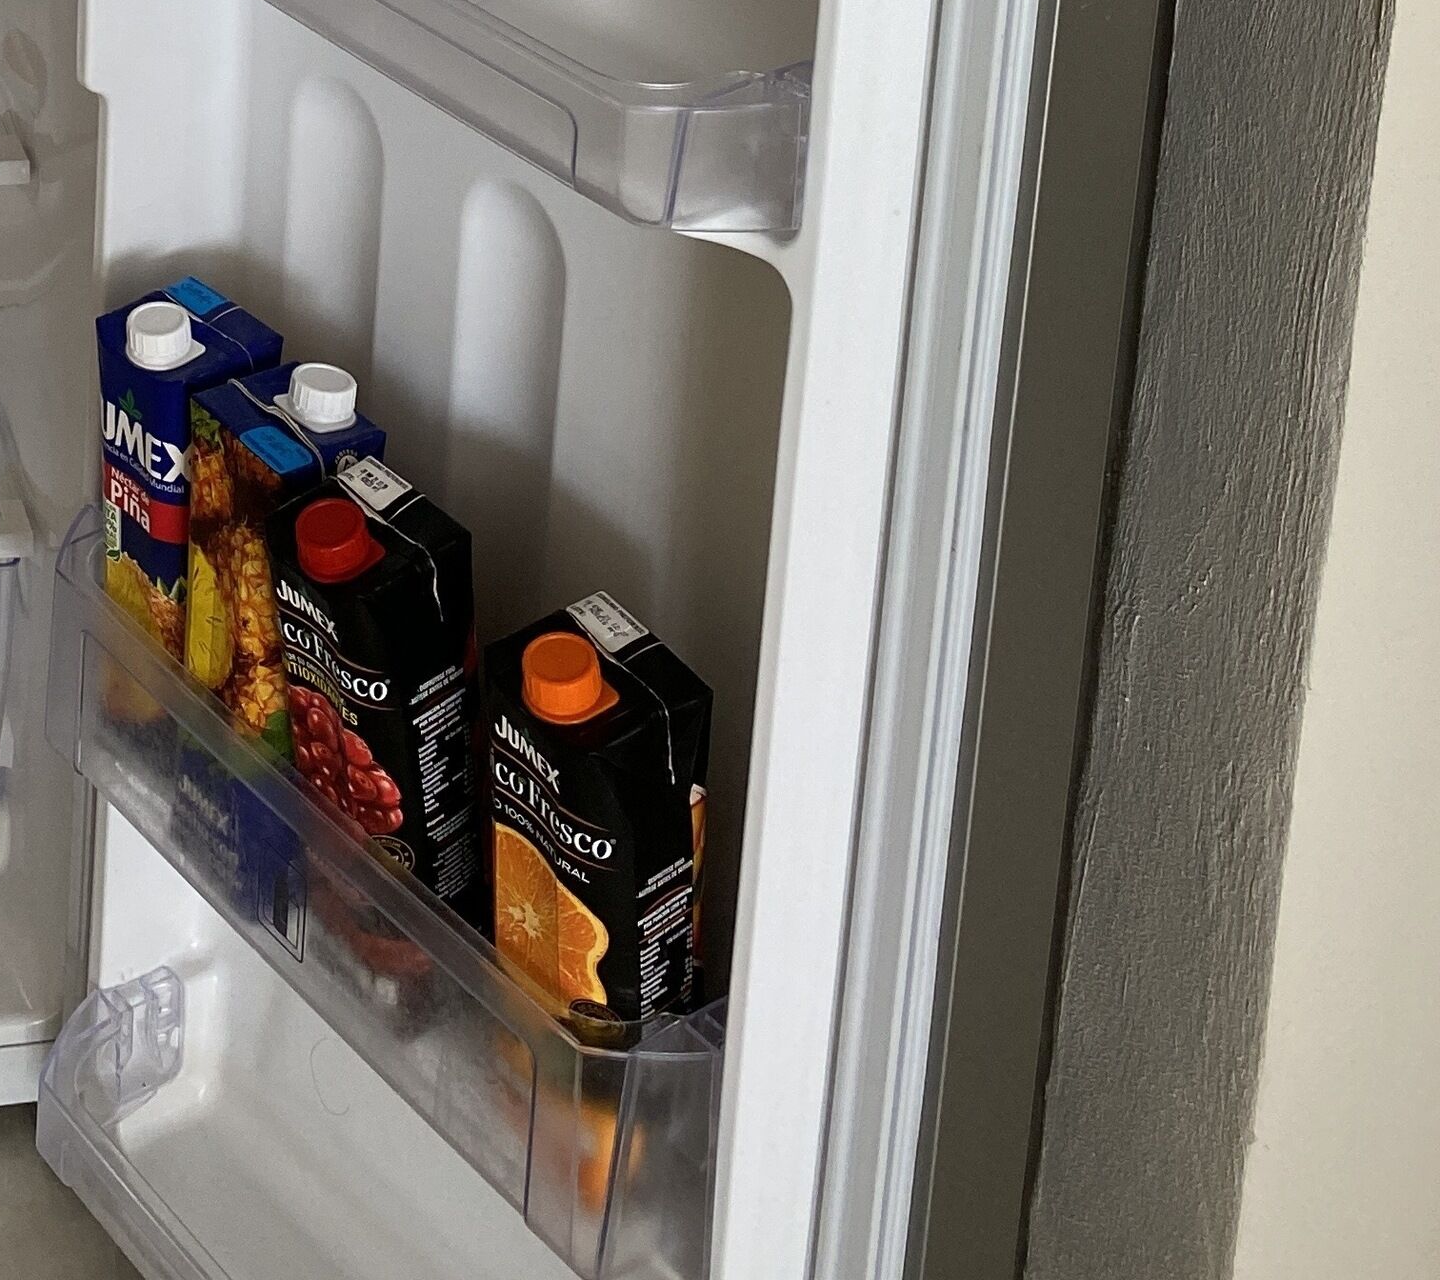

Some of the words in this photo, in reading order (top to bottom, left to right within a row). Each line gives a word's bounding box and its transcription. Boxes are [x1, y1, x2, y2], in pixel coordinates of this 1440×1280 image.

[110, 478, 150, 534] Piña
[149, 478, 185, 494] Mundial
[276, 579, 340, 643] JUMEX
[494, 714, 561, 795] JUMEX
[504, 803, 535, 834] 100%
[535, 831, 591, 885] NATURAL
